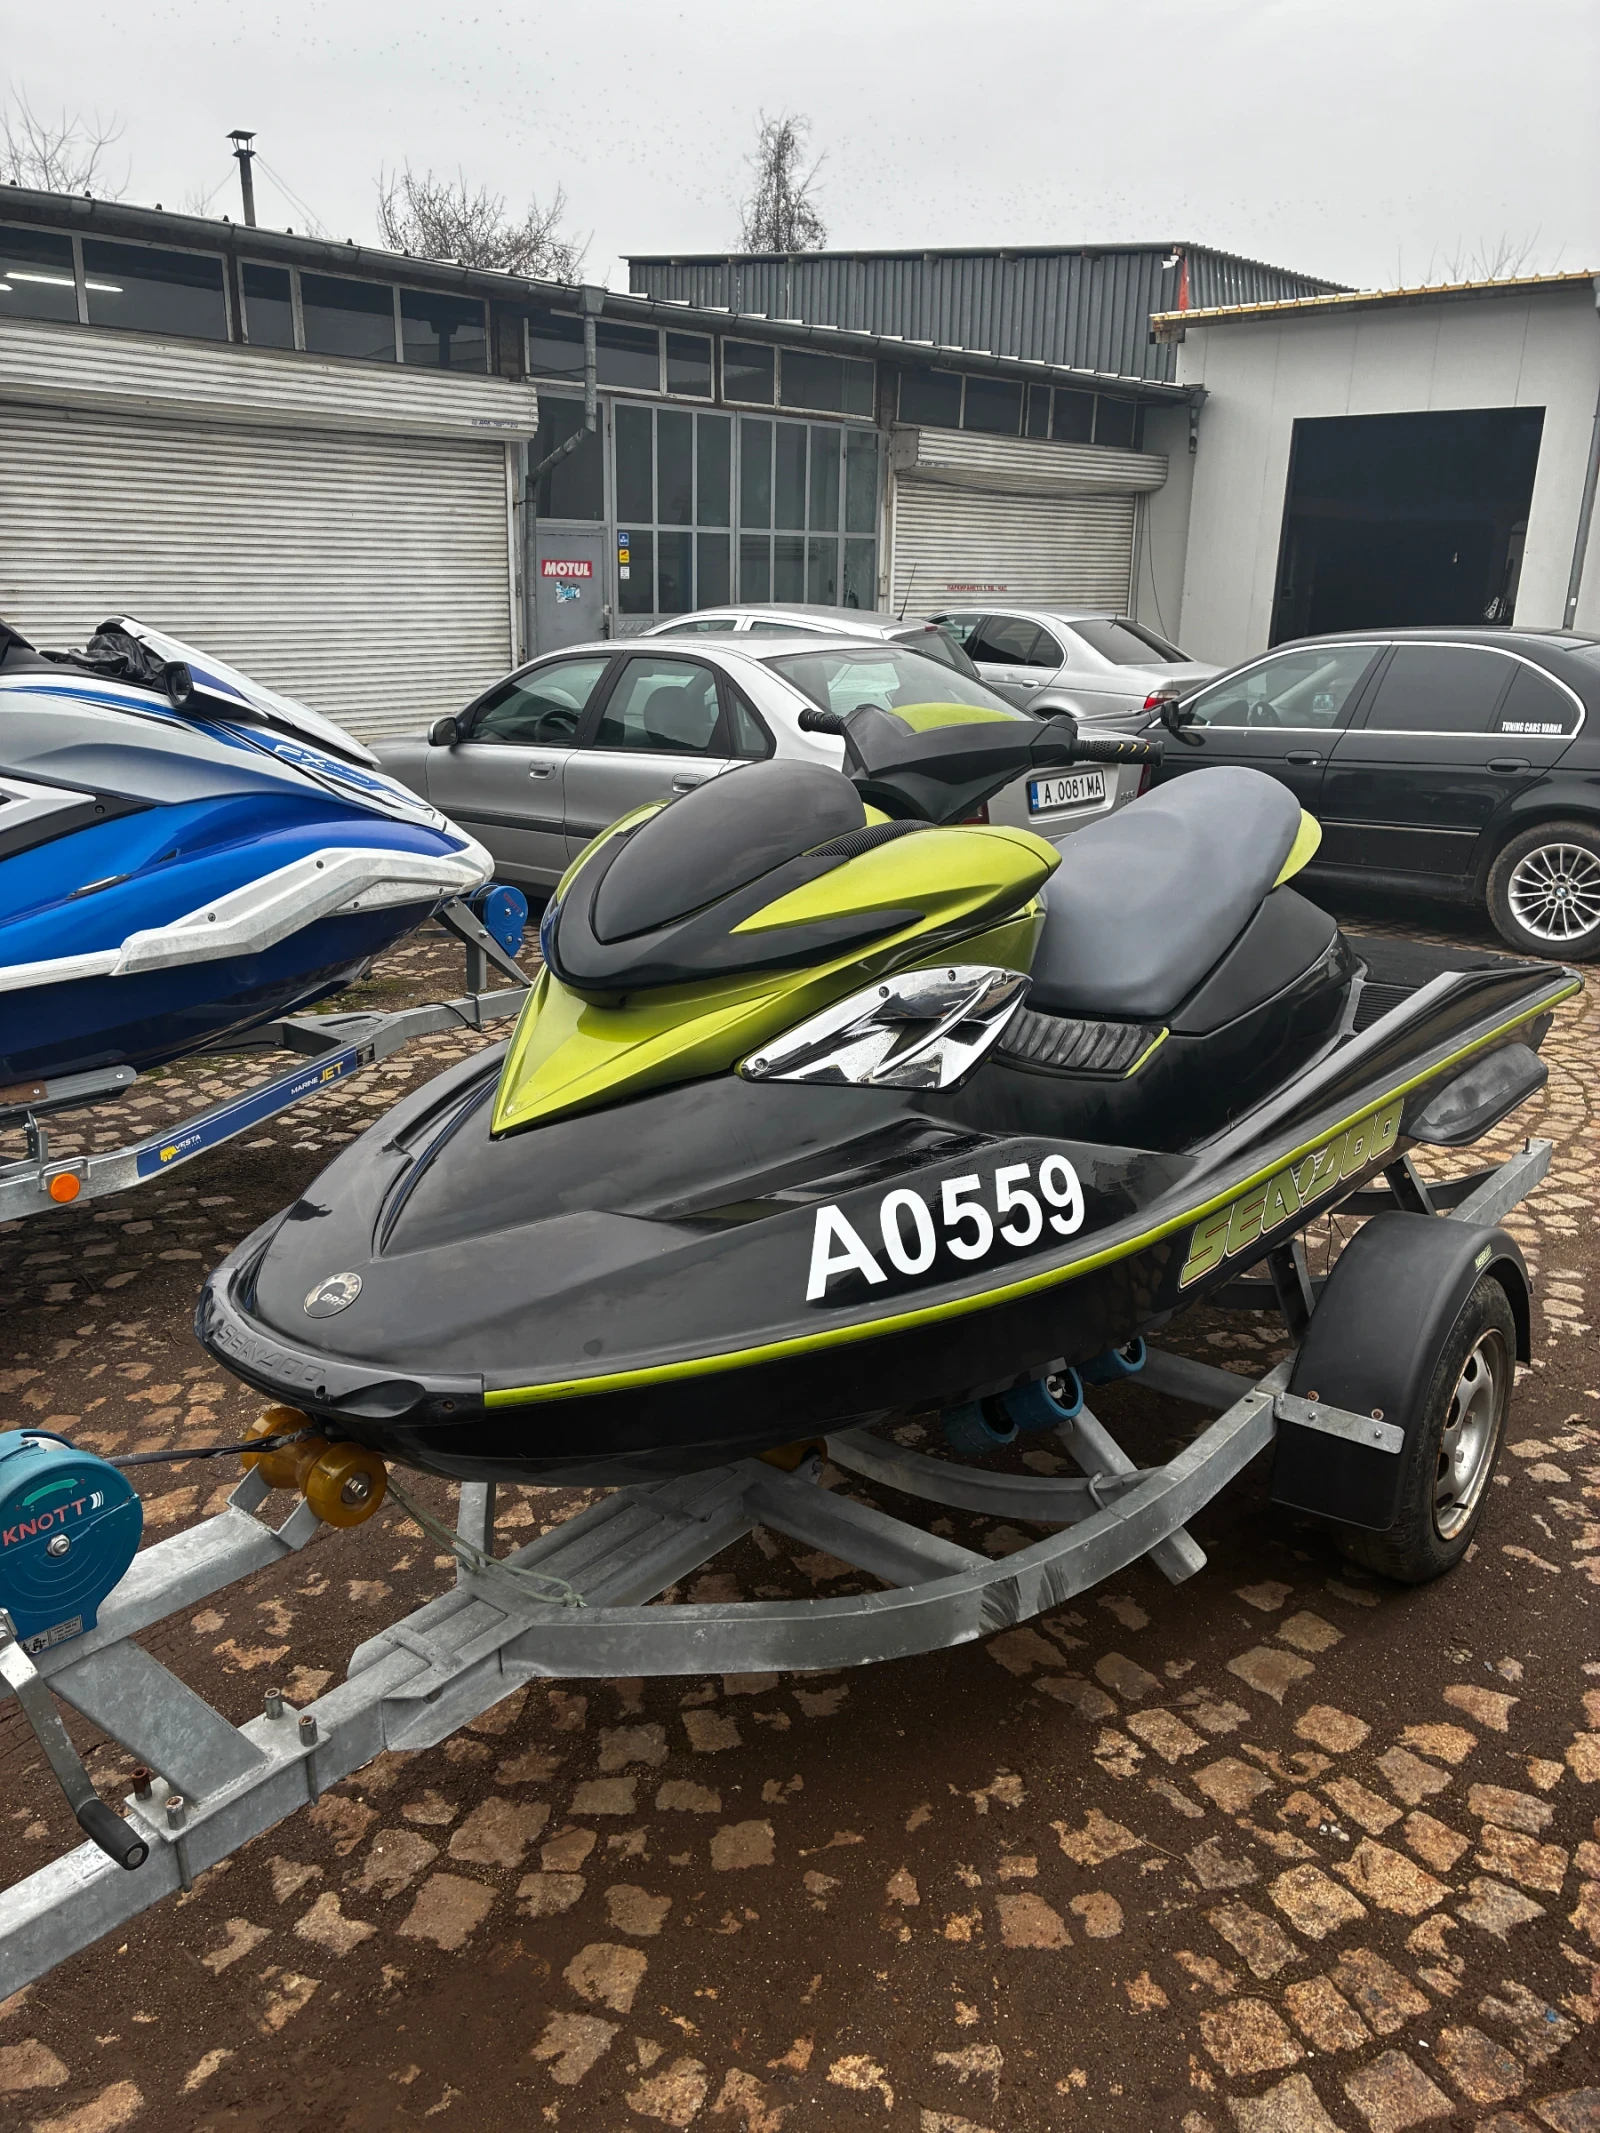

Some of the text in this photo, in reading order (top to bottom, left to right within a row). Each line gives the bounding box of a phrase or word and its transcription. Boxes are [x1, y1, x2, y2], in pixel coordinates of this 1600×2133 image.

[544, 562, 590, 576] MOTUL
[1502, 721, 1563, 734] TUNING CARS VARNA
[291, 1061, 344, 1095] MARINE JET
[175, 1134, 201, 1150] VESTA
[805, 1154, 1086, 1302] A0559
[320, 1293, 347, 1306] BRP
[3, 1497, 87, 1546] KNOTT
